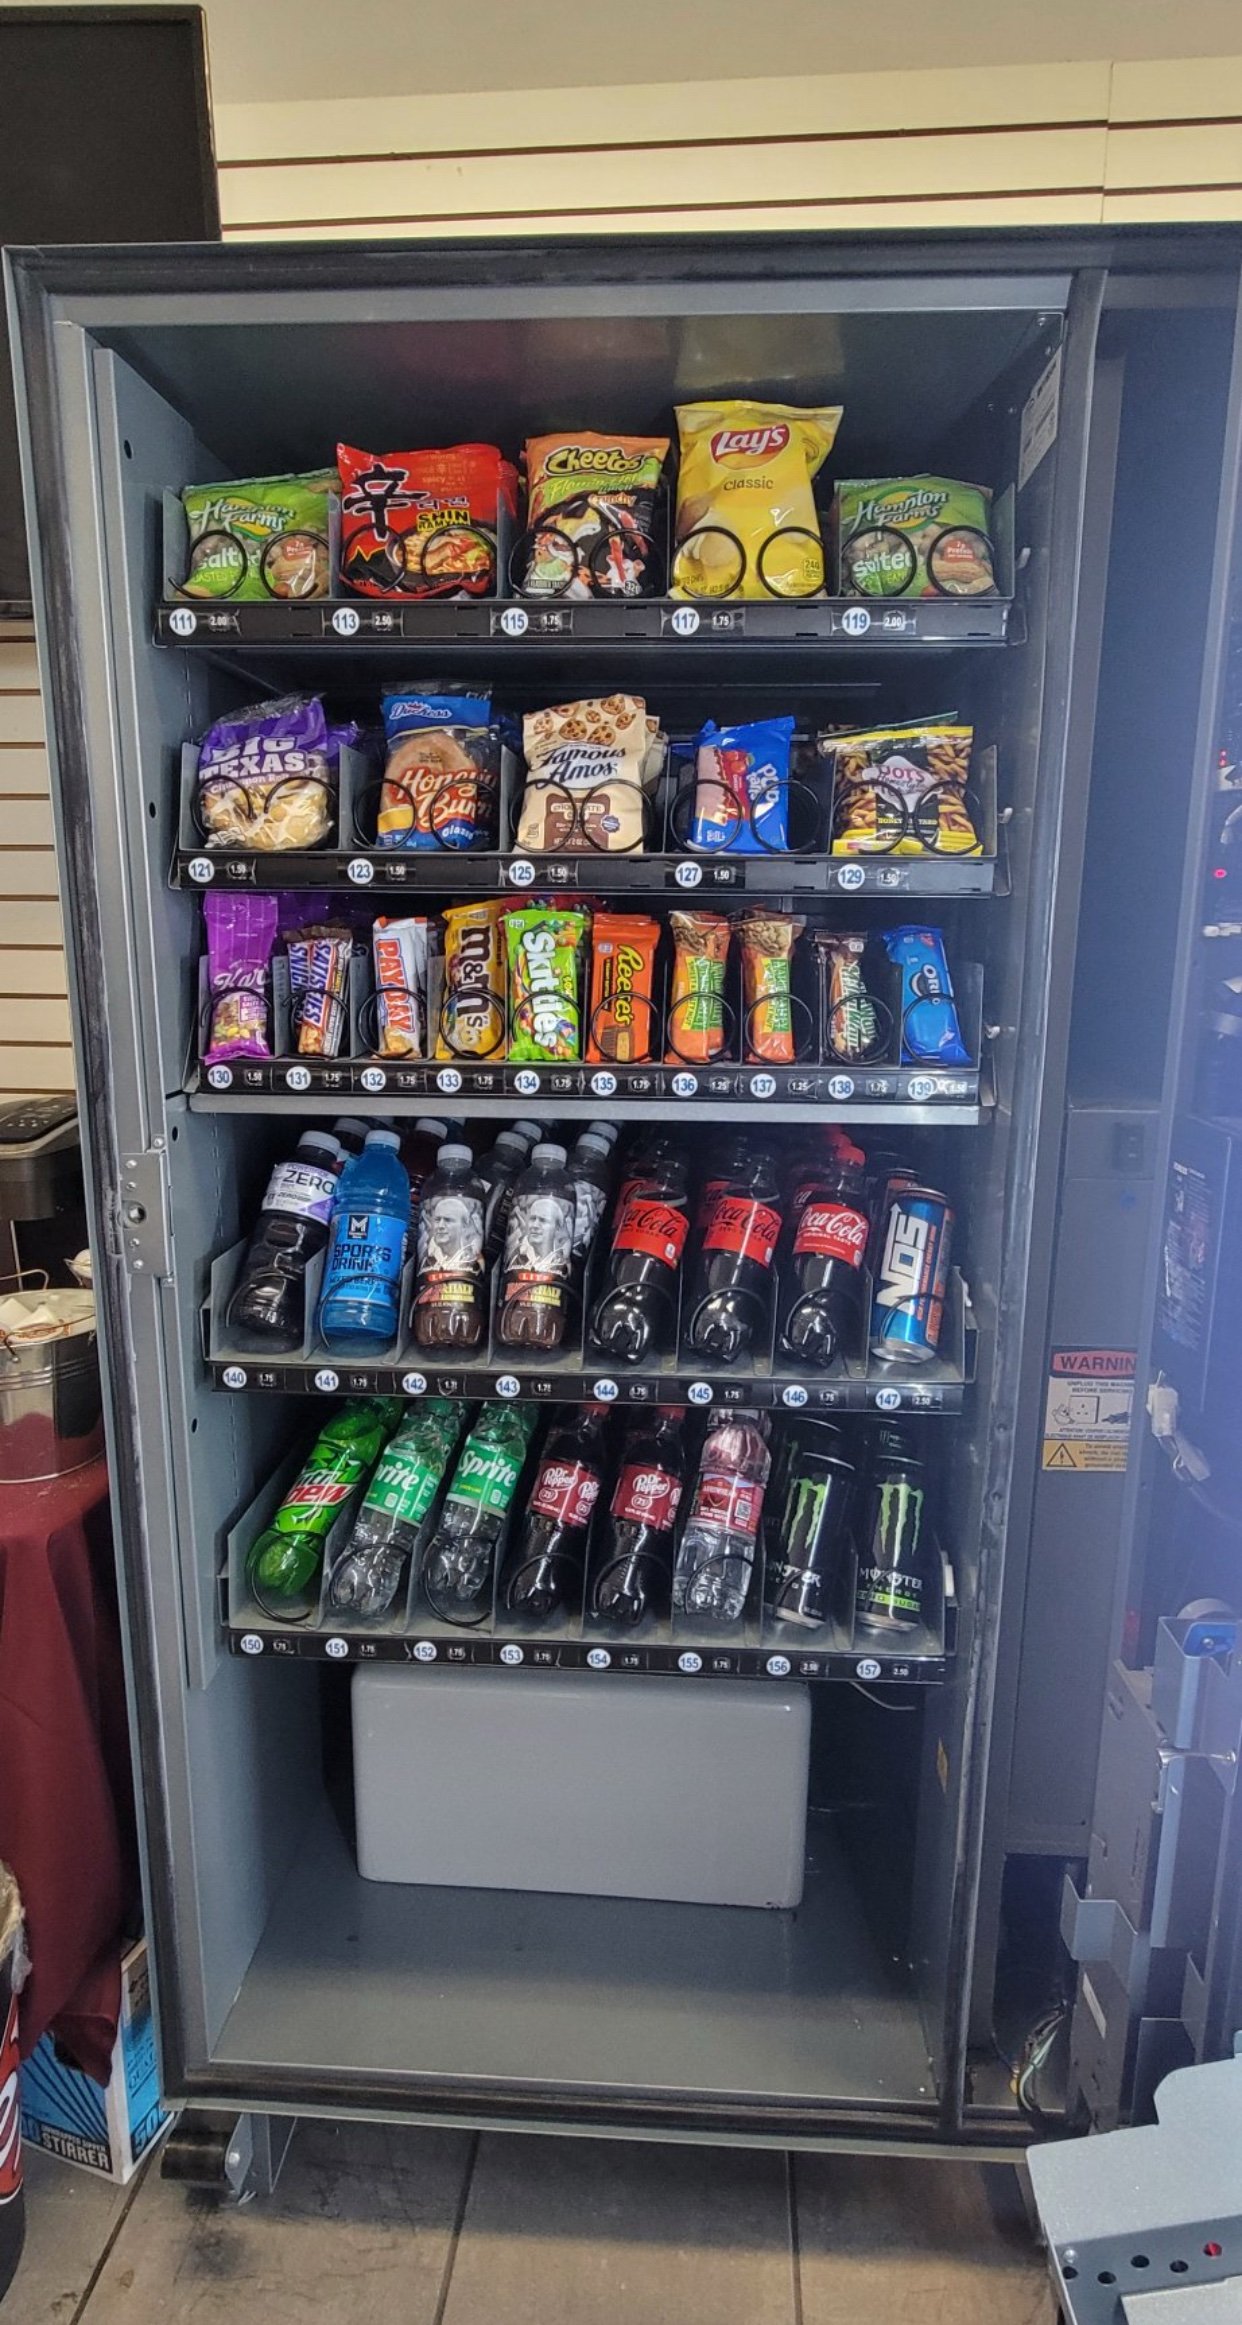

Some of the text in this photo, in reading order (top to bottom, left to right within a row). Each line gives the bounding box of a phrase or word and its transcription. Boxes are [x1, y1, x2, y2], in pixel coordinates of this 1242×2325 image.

[715, 425, 786, 455] Lay's
[548, 448, 643, 473] Cheetos
[723, 476, 775, 491] Classic
[342, 461, 431, 543] 辛
[417, 511, 469, 523] SHIN
[842, 490, 948, 532] Hampton
[222, 510, 288, 534] Farms
[877, 505, 941, 540] Farms
[199, 547, 262, 569] saltd
[852, 552, 922, 578] salte
[172, 614, 192, 630] 111
[334, 612, 358, 630] 113
[502, 614, 526, 630] 115
[674, 612, 698, 630] 117
[712, 616, 730, 626] 1.75
[844, 612, 868, 628] 119
[211, 736, 297, 763] BIG
[200, 752, 305, 780] TEXAS
[530, 748, 626, 773] Famous
[539, 761, 619, 787] Amos
[397, 769, 477, 798] Honey
[417, 793, 476, 826] Bun
[190, 862, 212, 878] 121
[350, 864, 372, 878] 123
[510, 866, 532, 880] 125
[676, 868, 700, 882] 127
[714, 870, 730, 880] 1.50
[838, 870, 862, 884] 129
[304, 943, 331, 1025] SATISIES
[522, 931, 564, 1048] Skittles
[614, 944, 644, 1026] Reese's
[208, 1070, 230, 1084] 130
[288, 1072, 308, 1086] 131
[362, 1072, 384, 1086] 132
[438, 1074, 460, 1088] 133
[516, 1076, 538, 1090] 134
[592, 1076, 614, 1090] 135
[674, 1078, 696, 1092] 136
[752, 1078, 774, 1092] 137
[830, 1080, 852, 1094] 138
[910, 1082, 932, 1096] 139
[283, 1169, 335, 1195] ZERO
[351, 1217, 369, 1232] M
[876, 1206, 929, 1315] NOS
[224, 1370, 246, 1384] 140
[316, 1374, 336, 1388] 141
[404, 1378, 424, 1390] 142
[496, 1380, 518, 1394] 143
[594, 1384, 616, 1396] 144
[690, 1386, 712, 1400] 145
[724, 1390, 739, 1399] 1.75
[784, 1388, 806, 1404] 146
[876, 1392, 898, 1406] 147
[457, 1449, 516, 1487] Sprite
[555, 1467, 568, 1478] Dr
[635, 1475, 668, 1493] Pepper
[648, 1475, 662, 1483] Dr
[242, 1638, 262, 1650] 150
[328, 1642, 346, 1654] 151
[414, 1646, 434, 1658] 152
[502, 1648, 522, 1662] 153
[588, 1652, 608, 1666] 154
[680, 1656, 700, 1668] 155
[768, 1660, 788, 1672] 156
[858, 1664, 878, 1676] 157
[42, 2131, 109, 2170] STIRRER
